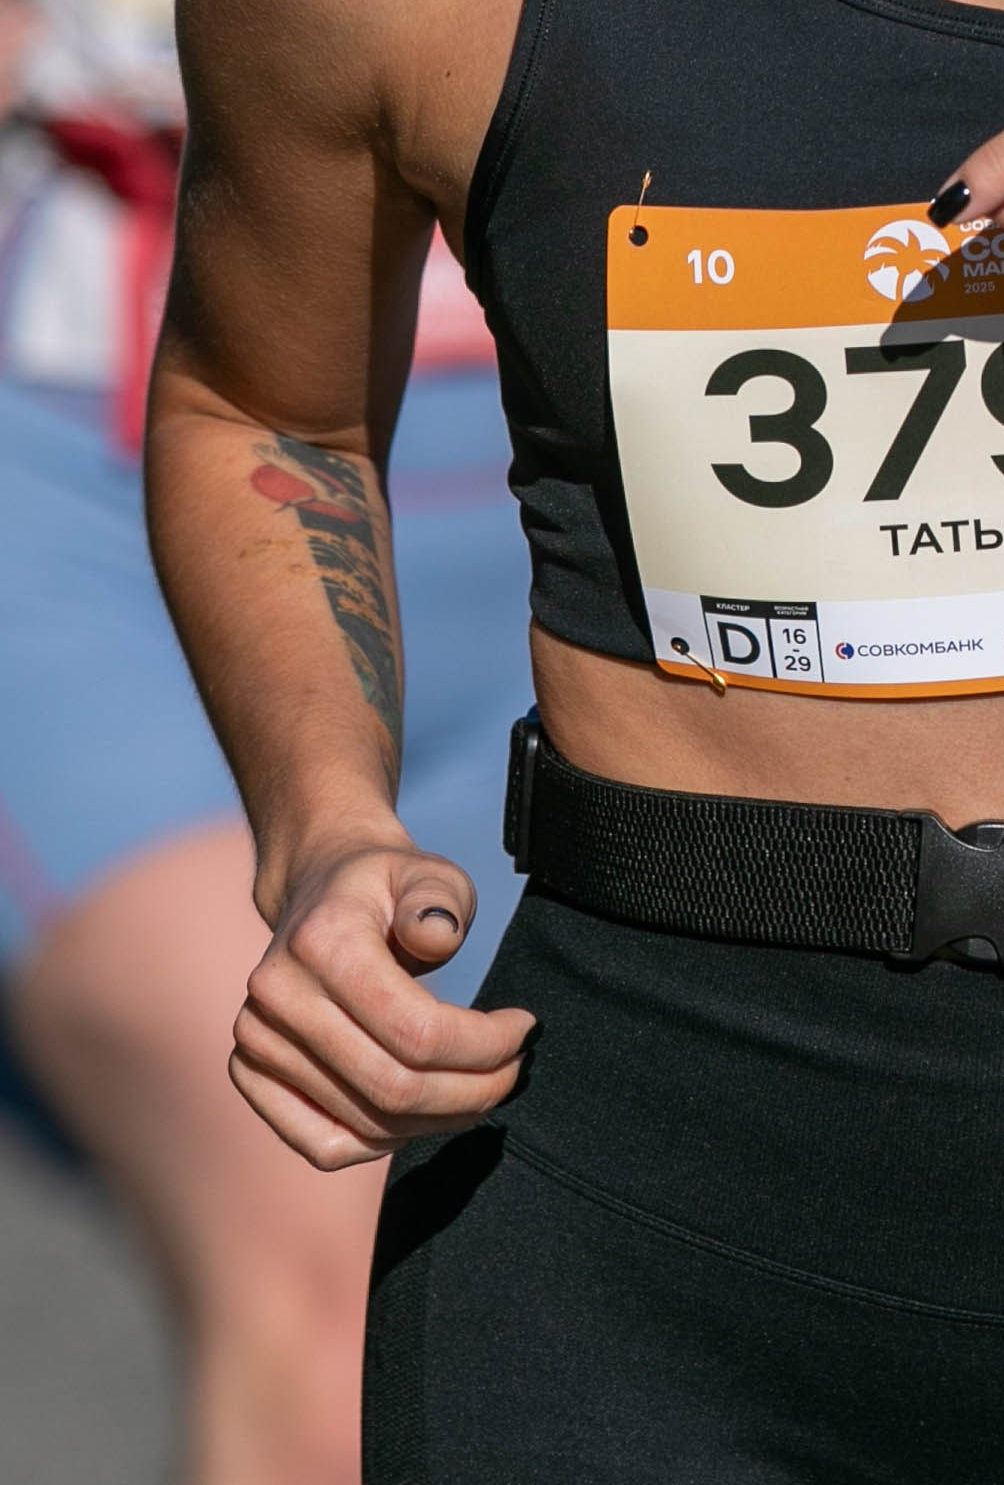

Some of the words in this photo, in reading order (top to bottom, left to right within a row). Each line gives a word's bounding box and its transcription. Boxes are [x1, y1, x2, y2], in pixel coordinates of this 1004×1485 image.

[686, 248, 736, 285] 10
[963, 281, 996, 295] 2025
[715, 602, 751, 612] КЛАСТЕР
[716, 621, 761, 665] D
[782, 628, 807, 645] 16
[857, 638, 985, 657] СОВКОМБАНК
[784, 655, 812, 672] 29
